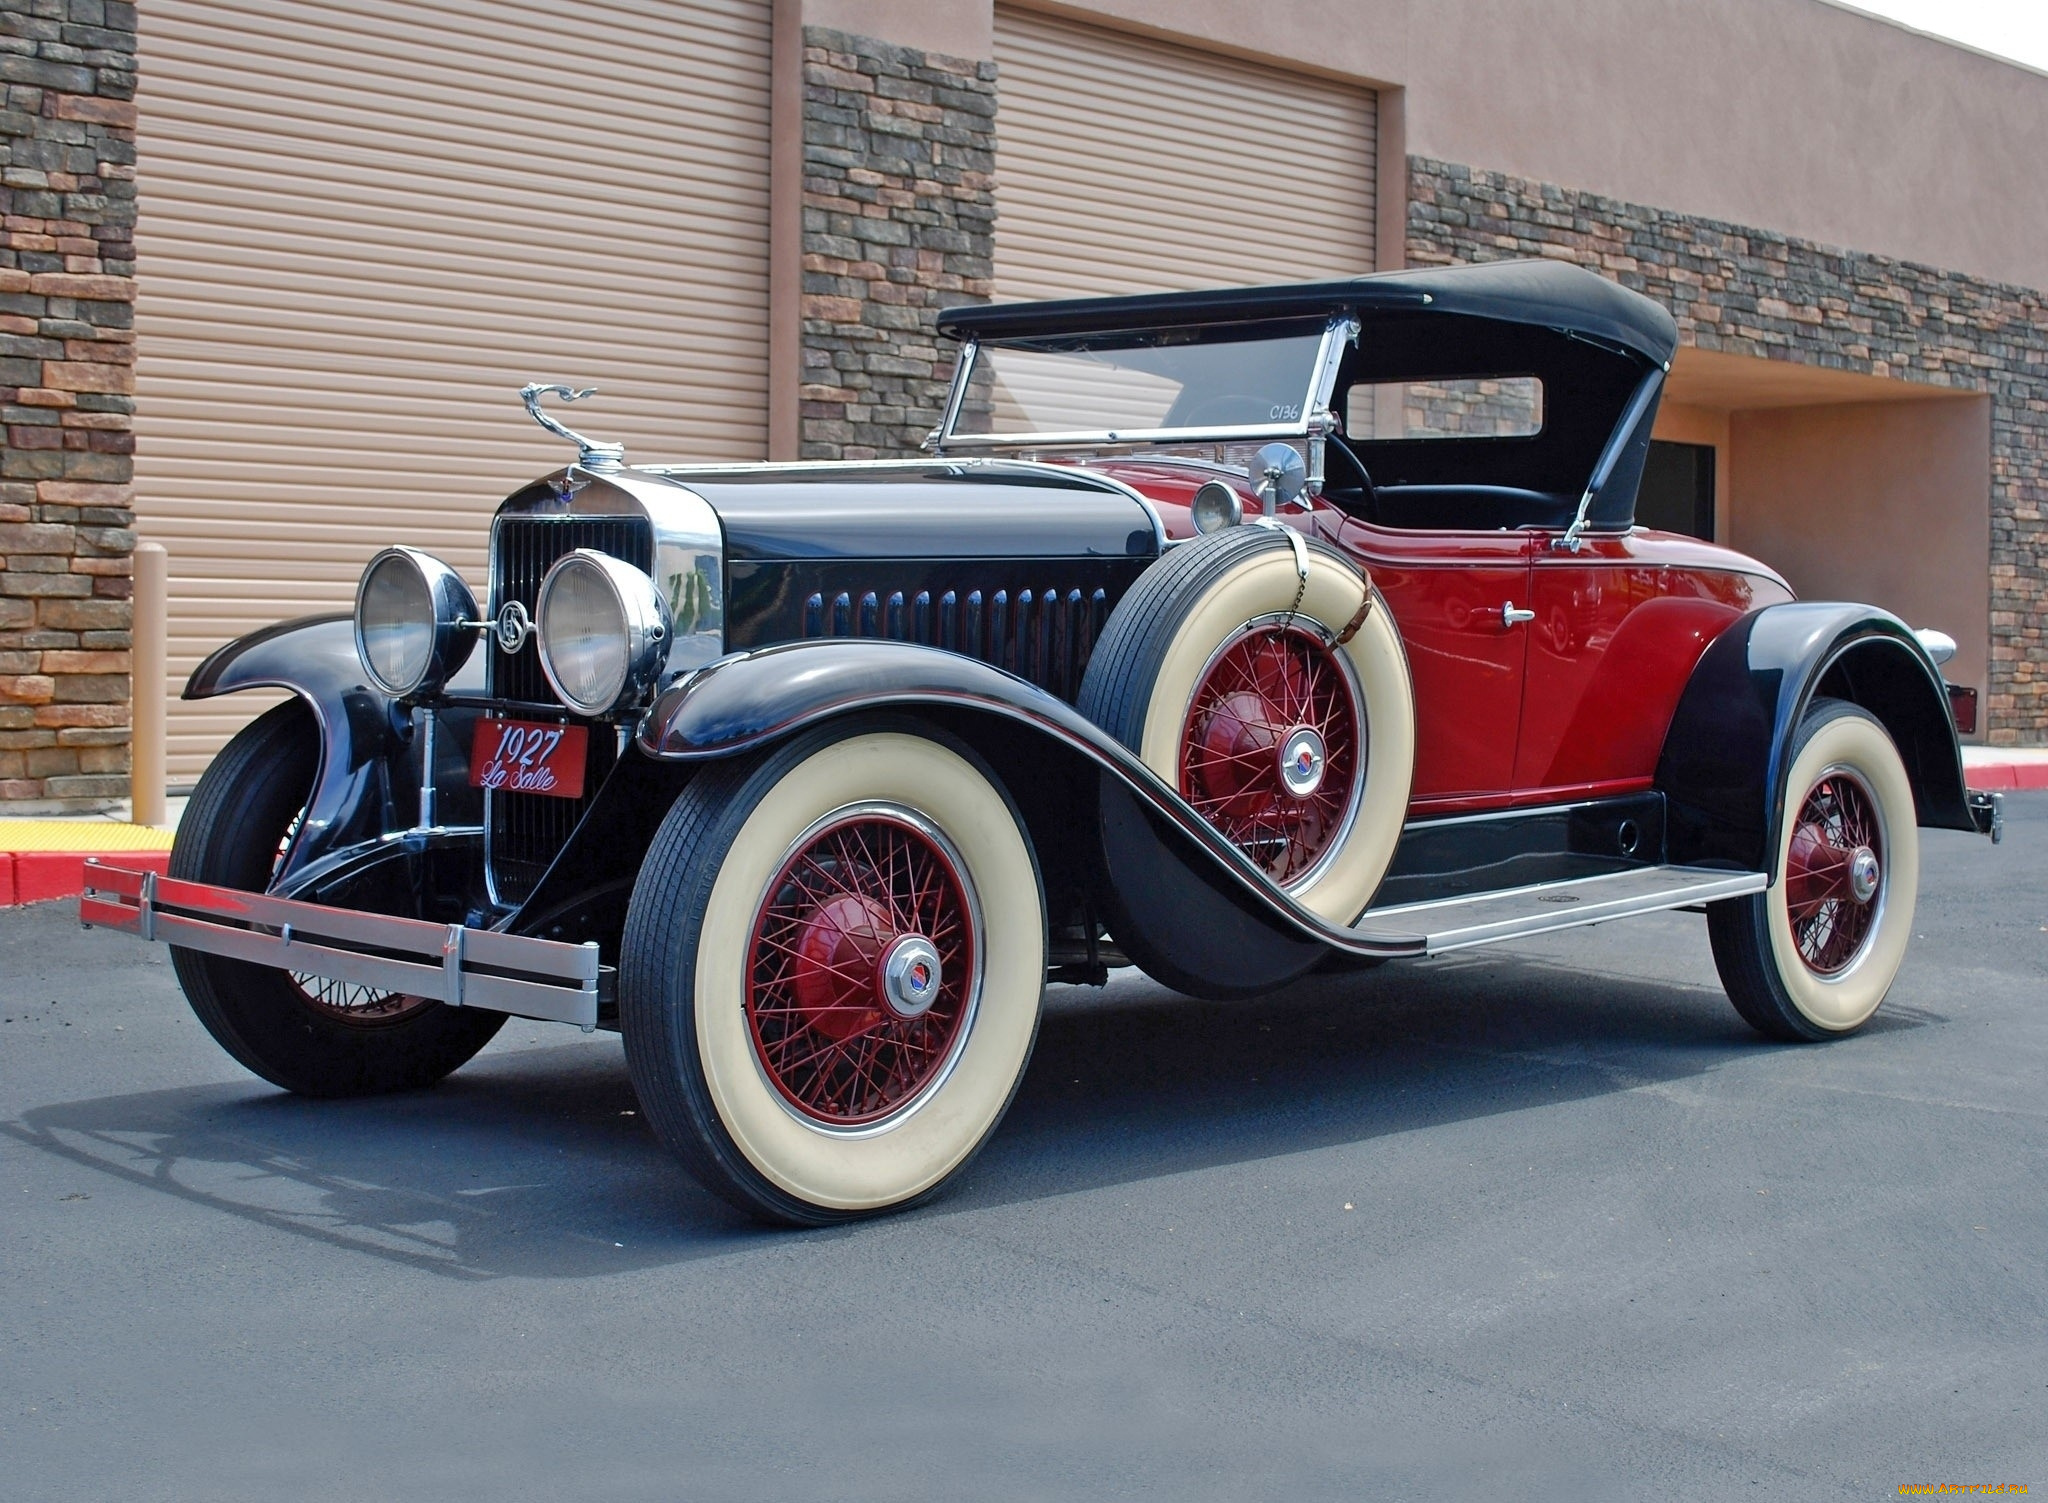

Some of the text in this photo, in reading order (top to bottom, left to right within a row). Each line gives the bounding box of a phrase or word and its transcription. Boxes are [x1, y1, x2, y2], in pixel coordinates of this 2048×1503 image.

[1270, 404, 1298, 420] C136
[494, 726, 560, 766] 1927
[480, 760, 558, 791] La Salle
